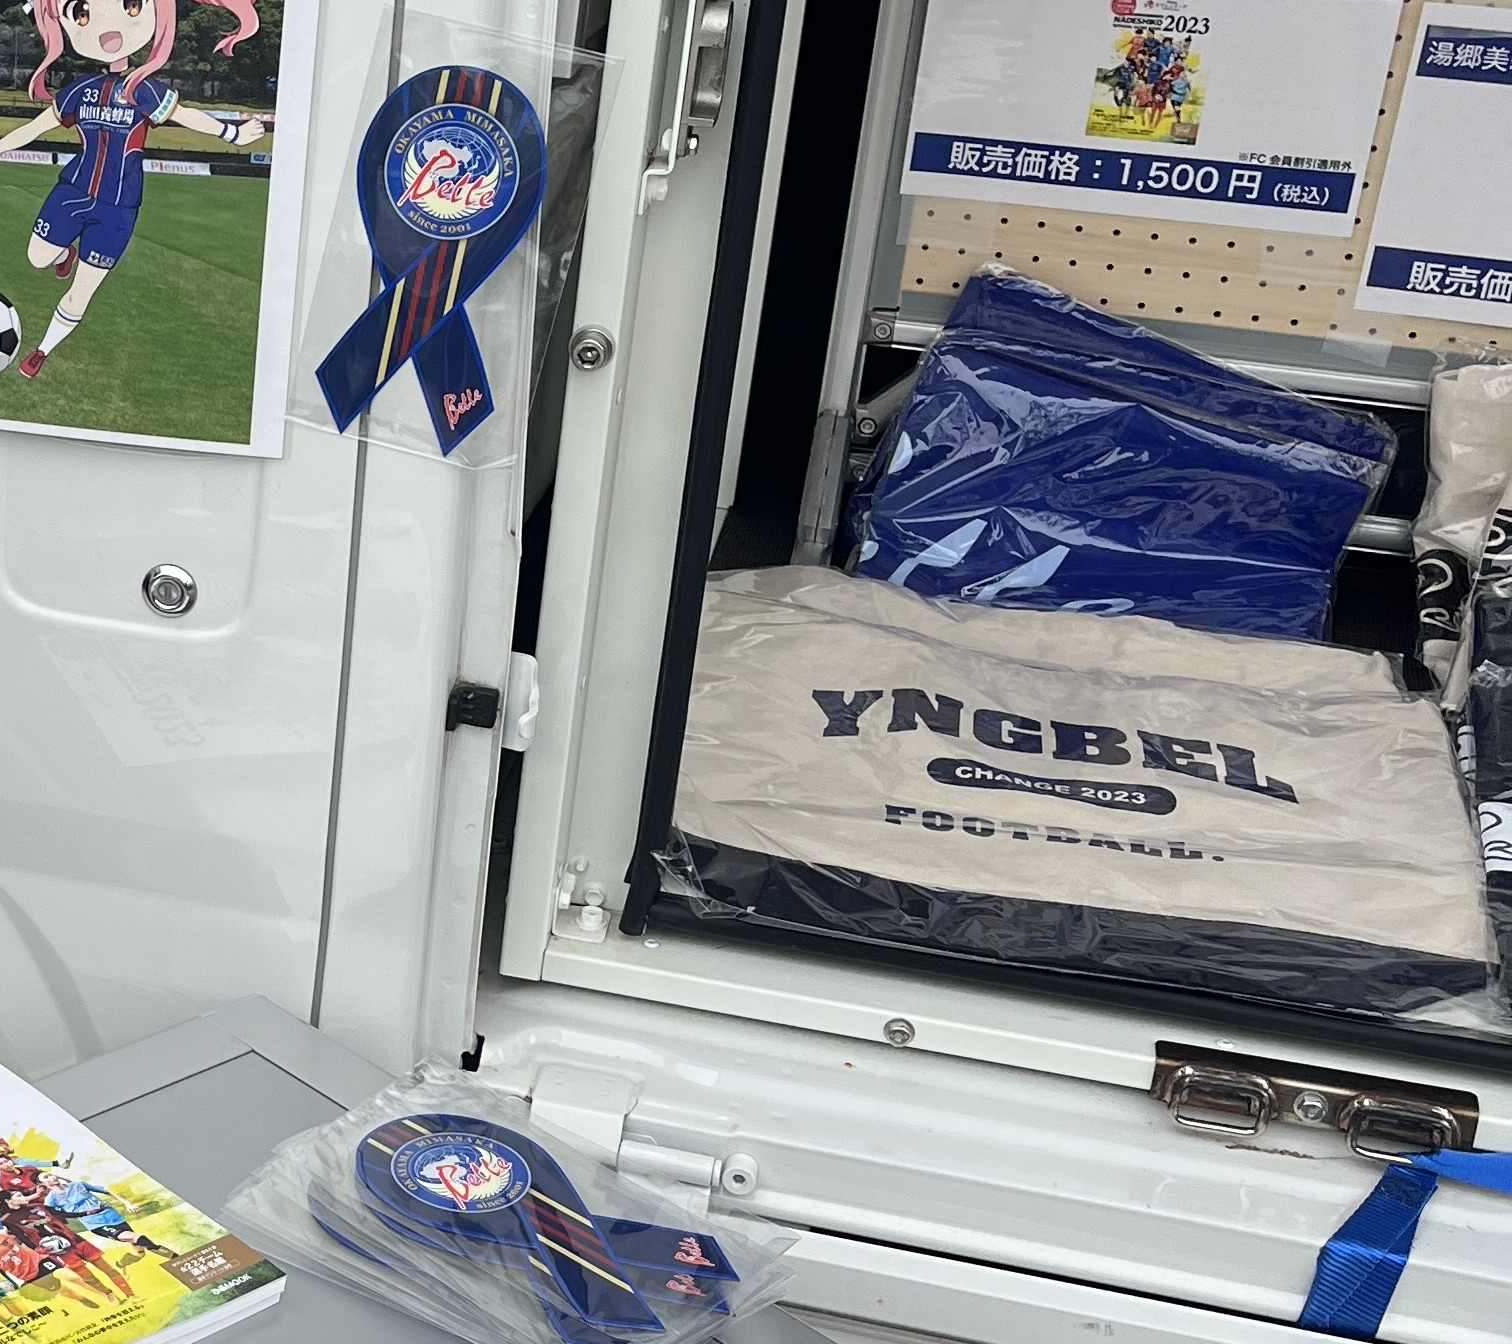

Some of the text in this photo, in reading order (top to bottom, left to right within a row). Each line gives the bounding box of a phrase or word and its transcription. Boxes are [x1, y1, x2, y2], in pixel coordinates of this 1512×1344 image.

[1163, 15, 1211, 35] 2023
[1425, 40, 1512, 72] 湯郷美
[82, 88, 100, 102] 33
[395, 110, 513, 179] OKAYAMA MIMASAKA
[150, 161, 196, 174] Plenus
[398, 149, 495, 208] Belle
[34, 218, 50, 237] 33
[407, 210, 438, 234] since
[443, 388, 483, 430] Belle
[811, 687, 1300, 805] YNGBEL
[1080, 781, 1147, 808] 2023
[415, 1135, 494, 1149] MIMASAKA
[435, 1157, 512, 1210] Belle
[476, 1196, 507, 1209] since
